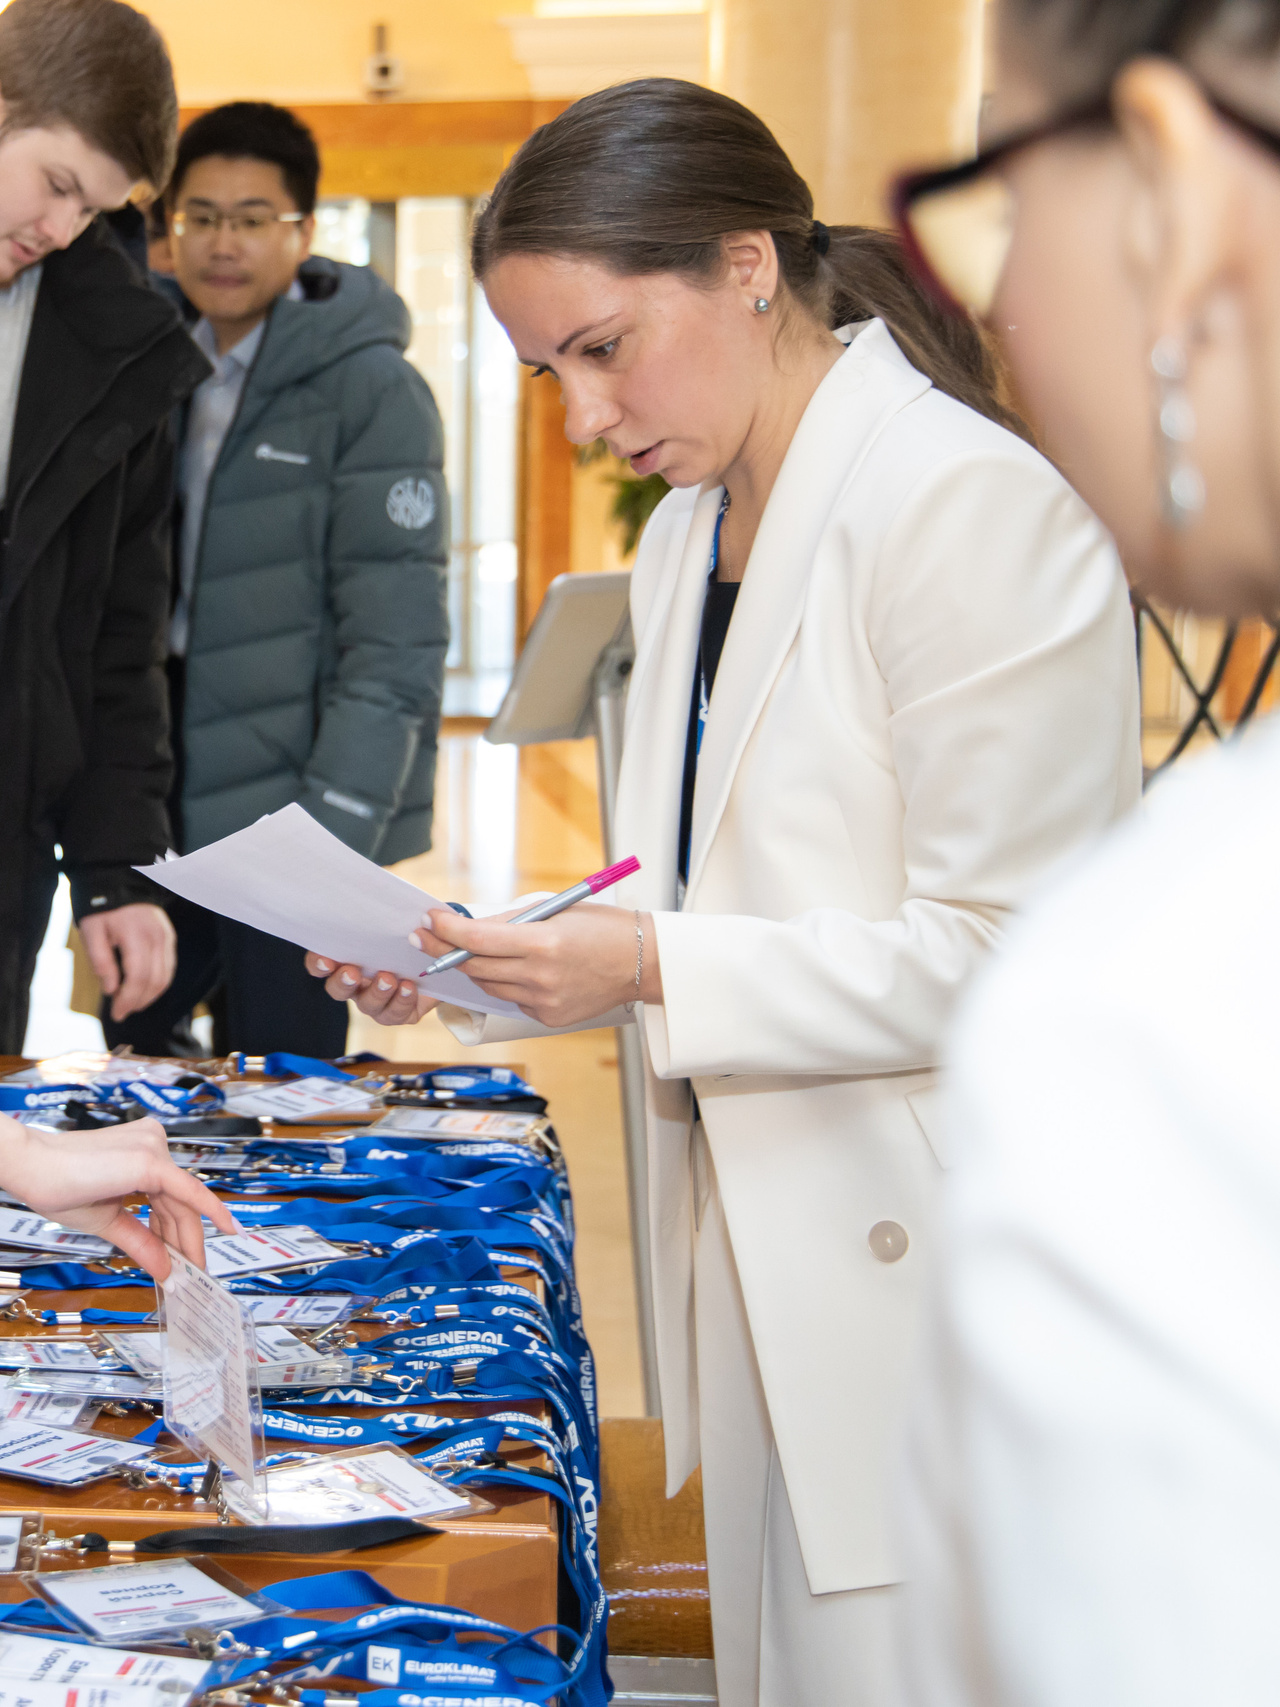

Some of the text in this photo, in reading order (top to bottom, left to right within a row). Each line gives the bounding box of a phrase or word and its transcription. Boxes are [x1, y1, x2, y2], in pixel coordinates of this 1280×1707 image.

[410, 1330, 510, 1347] GENERAL
[98, 1582, 176, 1597] Корнев
[108, 1588, 184, 1603] Сергей
[371, 1656, 394, 1672] EK
